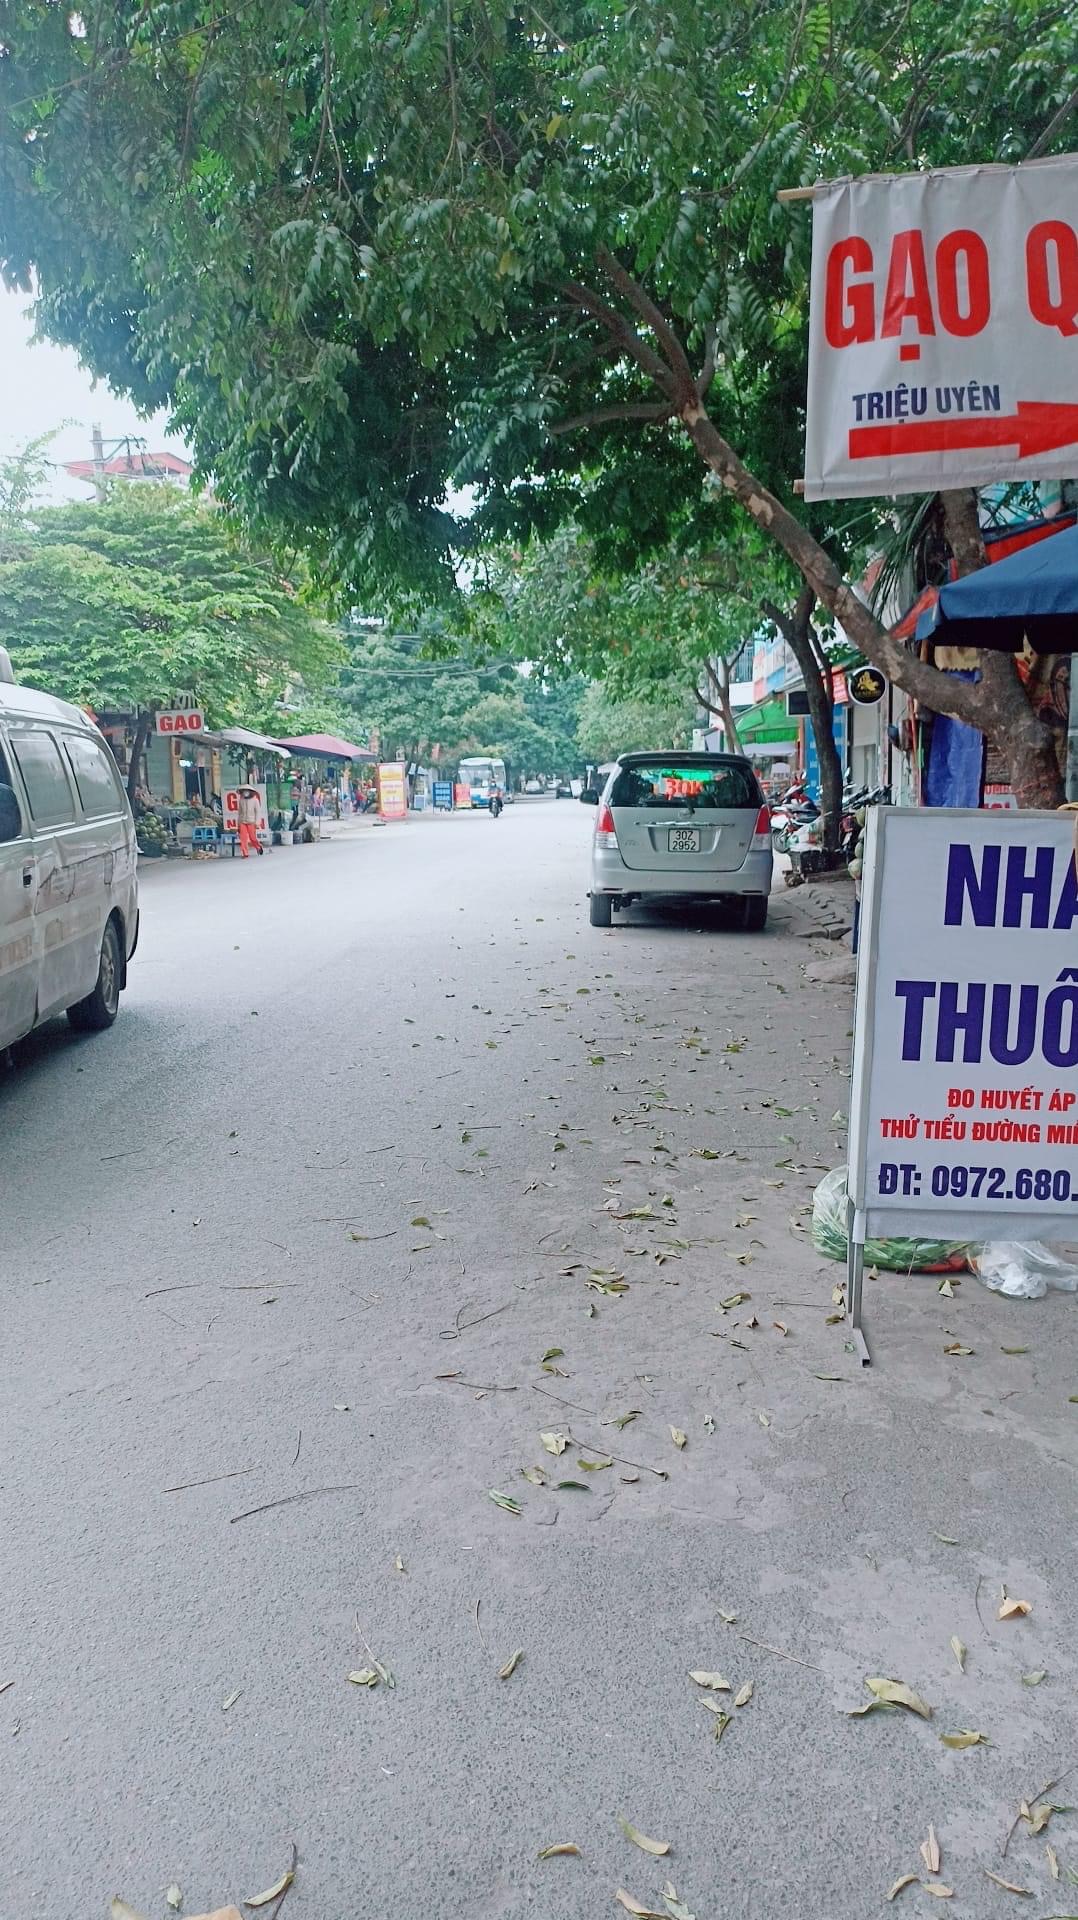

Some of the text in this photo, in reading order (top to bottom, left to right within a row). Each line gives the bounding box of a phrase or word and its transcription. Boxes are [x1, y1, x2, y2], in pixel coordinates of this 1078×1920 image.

[825, 229, 991, 361] GẠO
[852, 380, 1002, 424] TRIỆU UYÊN
[159, 714, 202, 734] GẠO
[672, 840, 697, 851] 2952
[675, 830, 694, 841] 30Z
[947, 1085, 1076, 1113] ĐO HUYẾT ÁP
[880, 1113, 920, 1140] THỬ
[924, 1113, 966, 1141] TIỂU
[972, 1118, 1041, 1144] ĐƯỜNG
[878, 1163, 921, 1197] ĐT:
